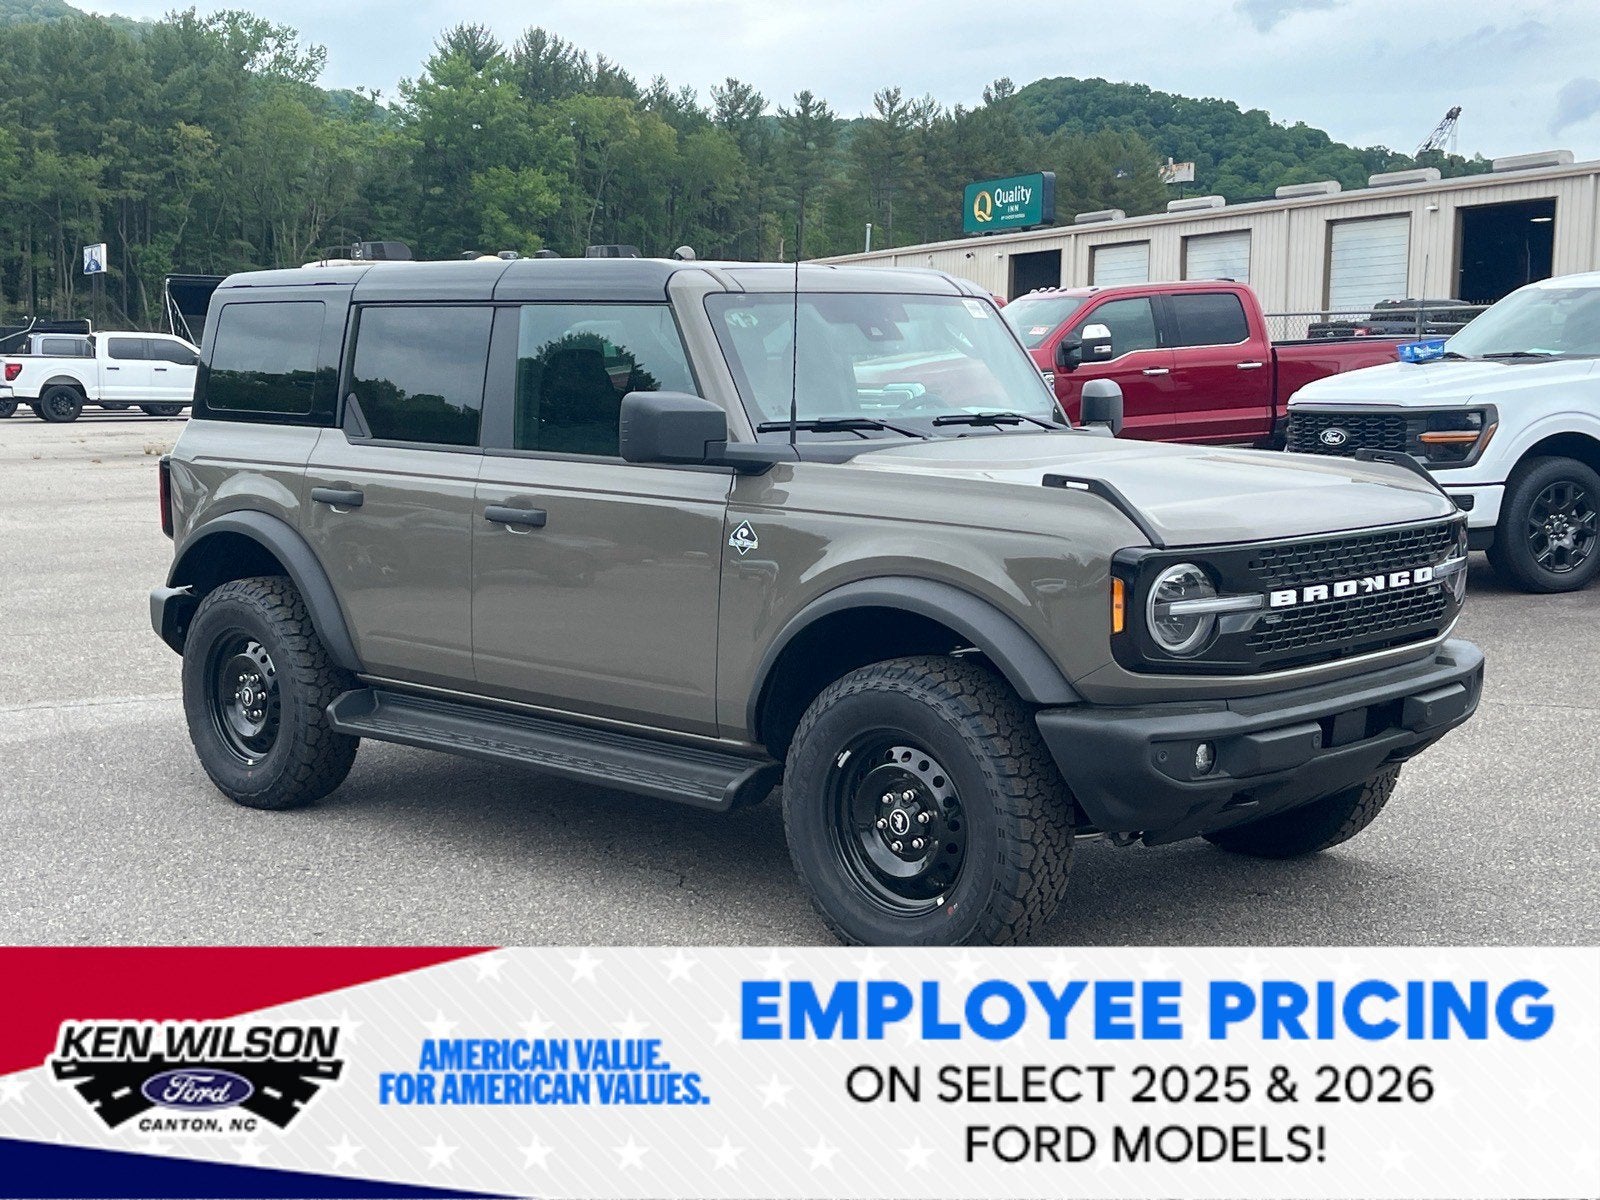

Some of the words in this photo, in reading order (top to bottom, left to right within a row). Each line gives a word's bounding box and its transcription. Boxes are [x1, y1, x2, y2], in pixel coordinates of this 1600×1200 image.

[994, 185, 1032, 207] Quality
[1007, 204, 1020, 213] INN
[1269, 566, 1434, 608] BRONCO
